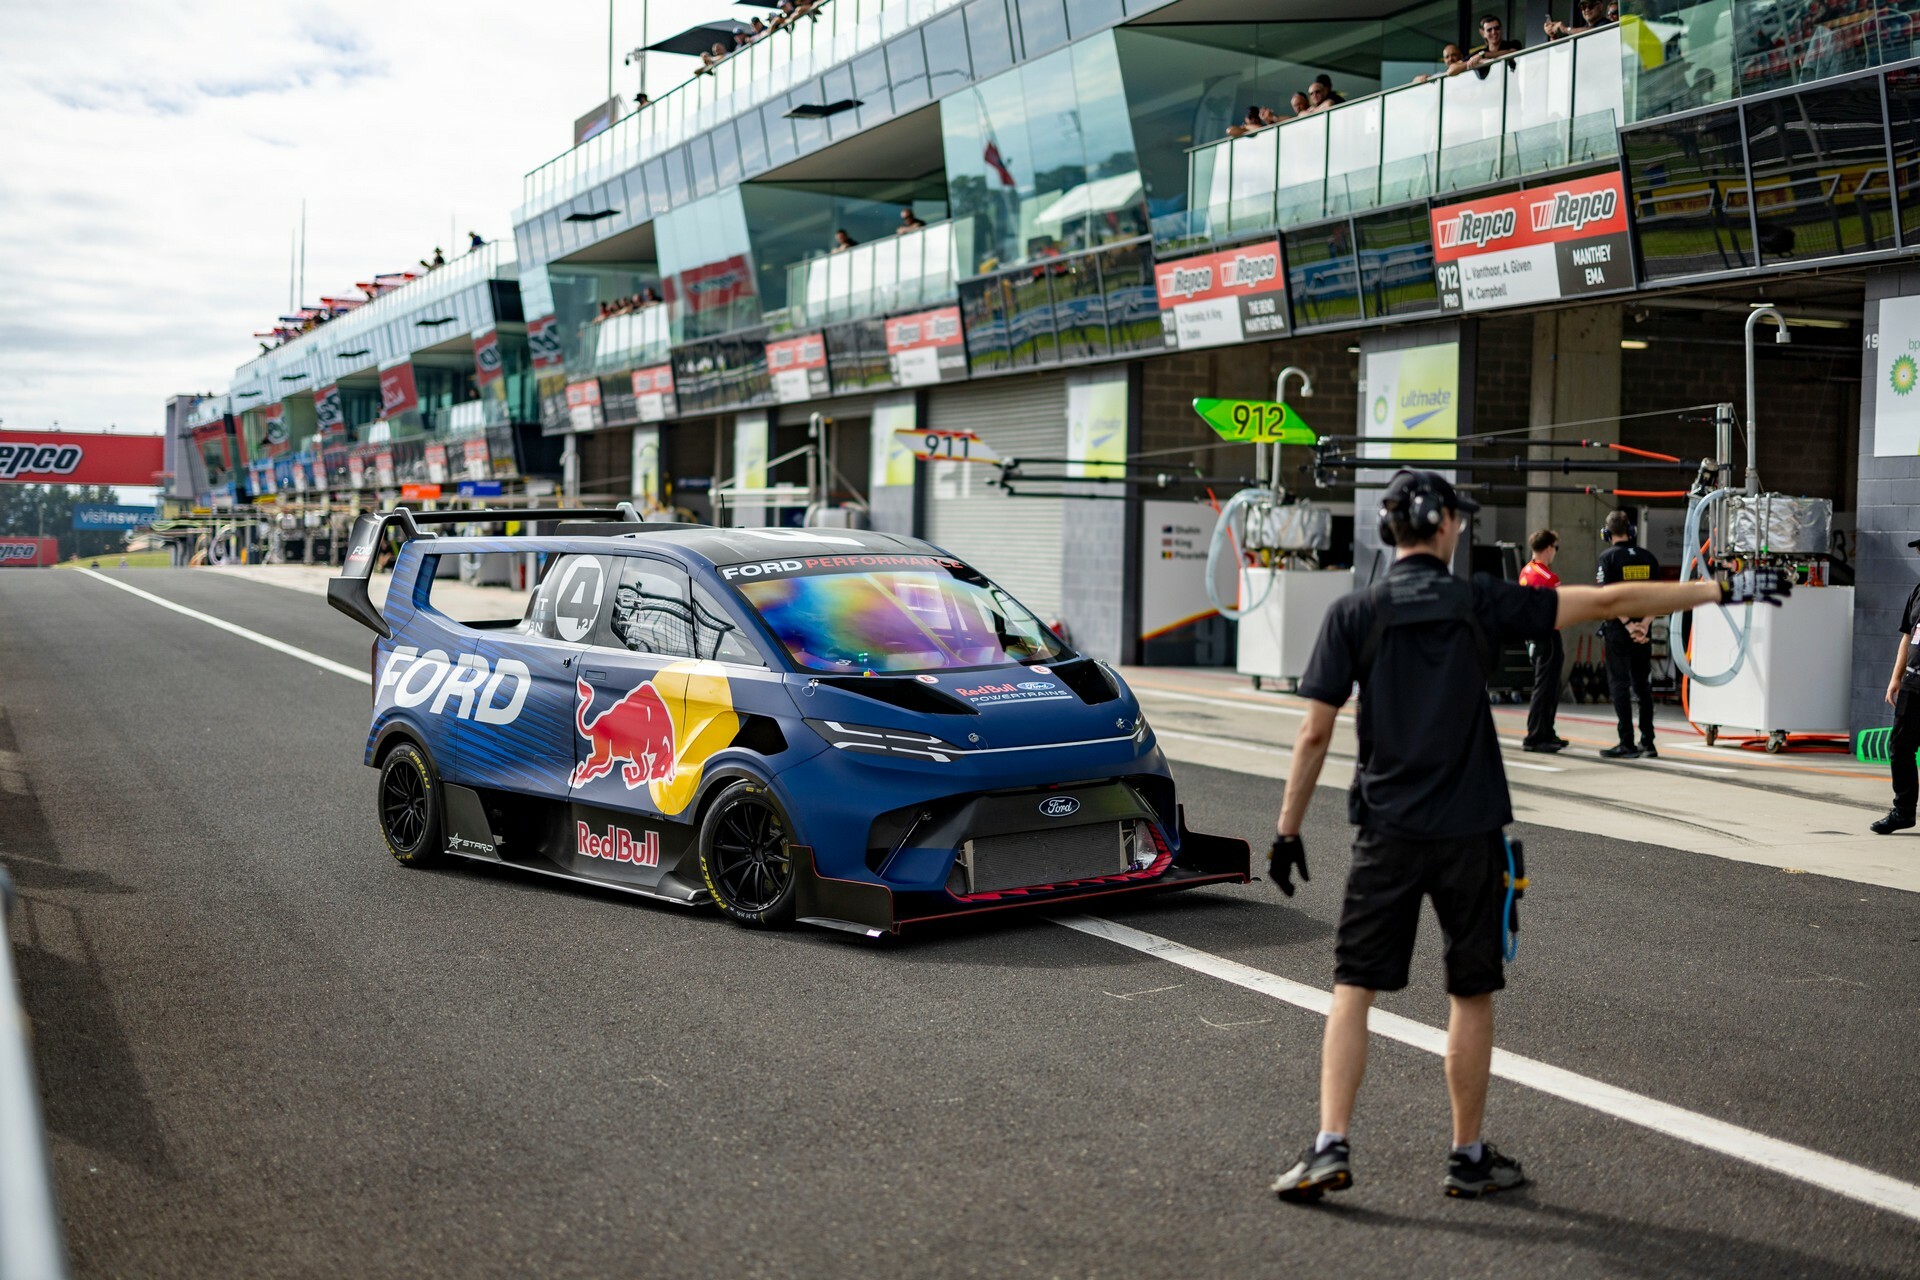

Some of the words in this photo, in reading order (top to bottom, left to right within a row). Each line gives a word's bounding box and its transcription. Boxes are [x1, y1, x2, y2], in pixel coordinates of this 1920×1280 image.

[1554, 189, 1616, 229] Repco
[1460, 208, 1515, 246] Repco
[1572, 244, 1611, 266] MANTHEY
[1174, 268, 1210, 295] Repco
[1237, 257, 1275, 285] Repco
[1438, 265, 1459, 290] 912
[1585, 269, 1605, 286] EMA
[1476, 284, 1508, 301] Campbell
[1401, 387, 1451, 408] ultimate
[1233, 404, 1284, 437] 912
[925, 434, 970, 458] 911
[722, 560, 803, 580] FORD
[804, 556, 964, 569] PERFORMANCE
[375, 645, 532, 725] FORD
[970, 690, 1068, 702] POWERTRAINS
[1047, 799, 1073, 814] Ford
[700, 856, 728, 909] PIRELLI
